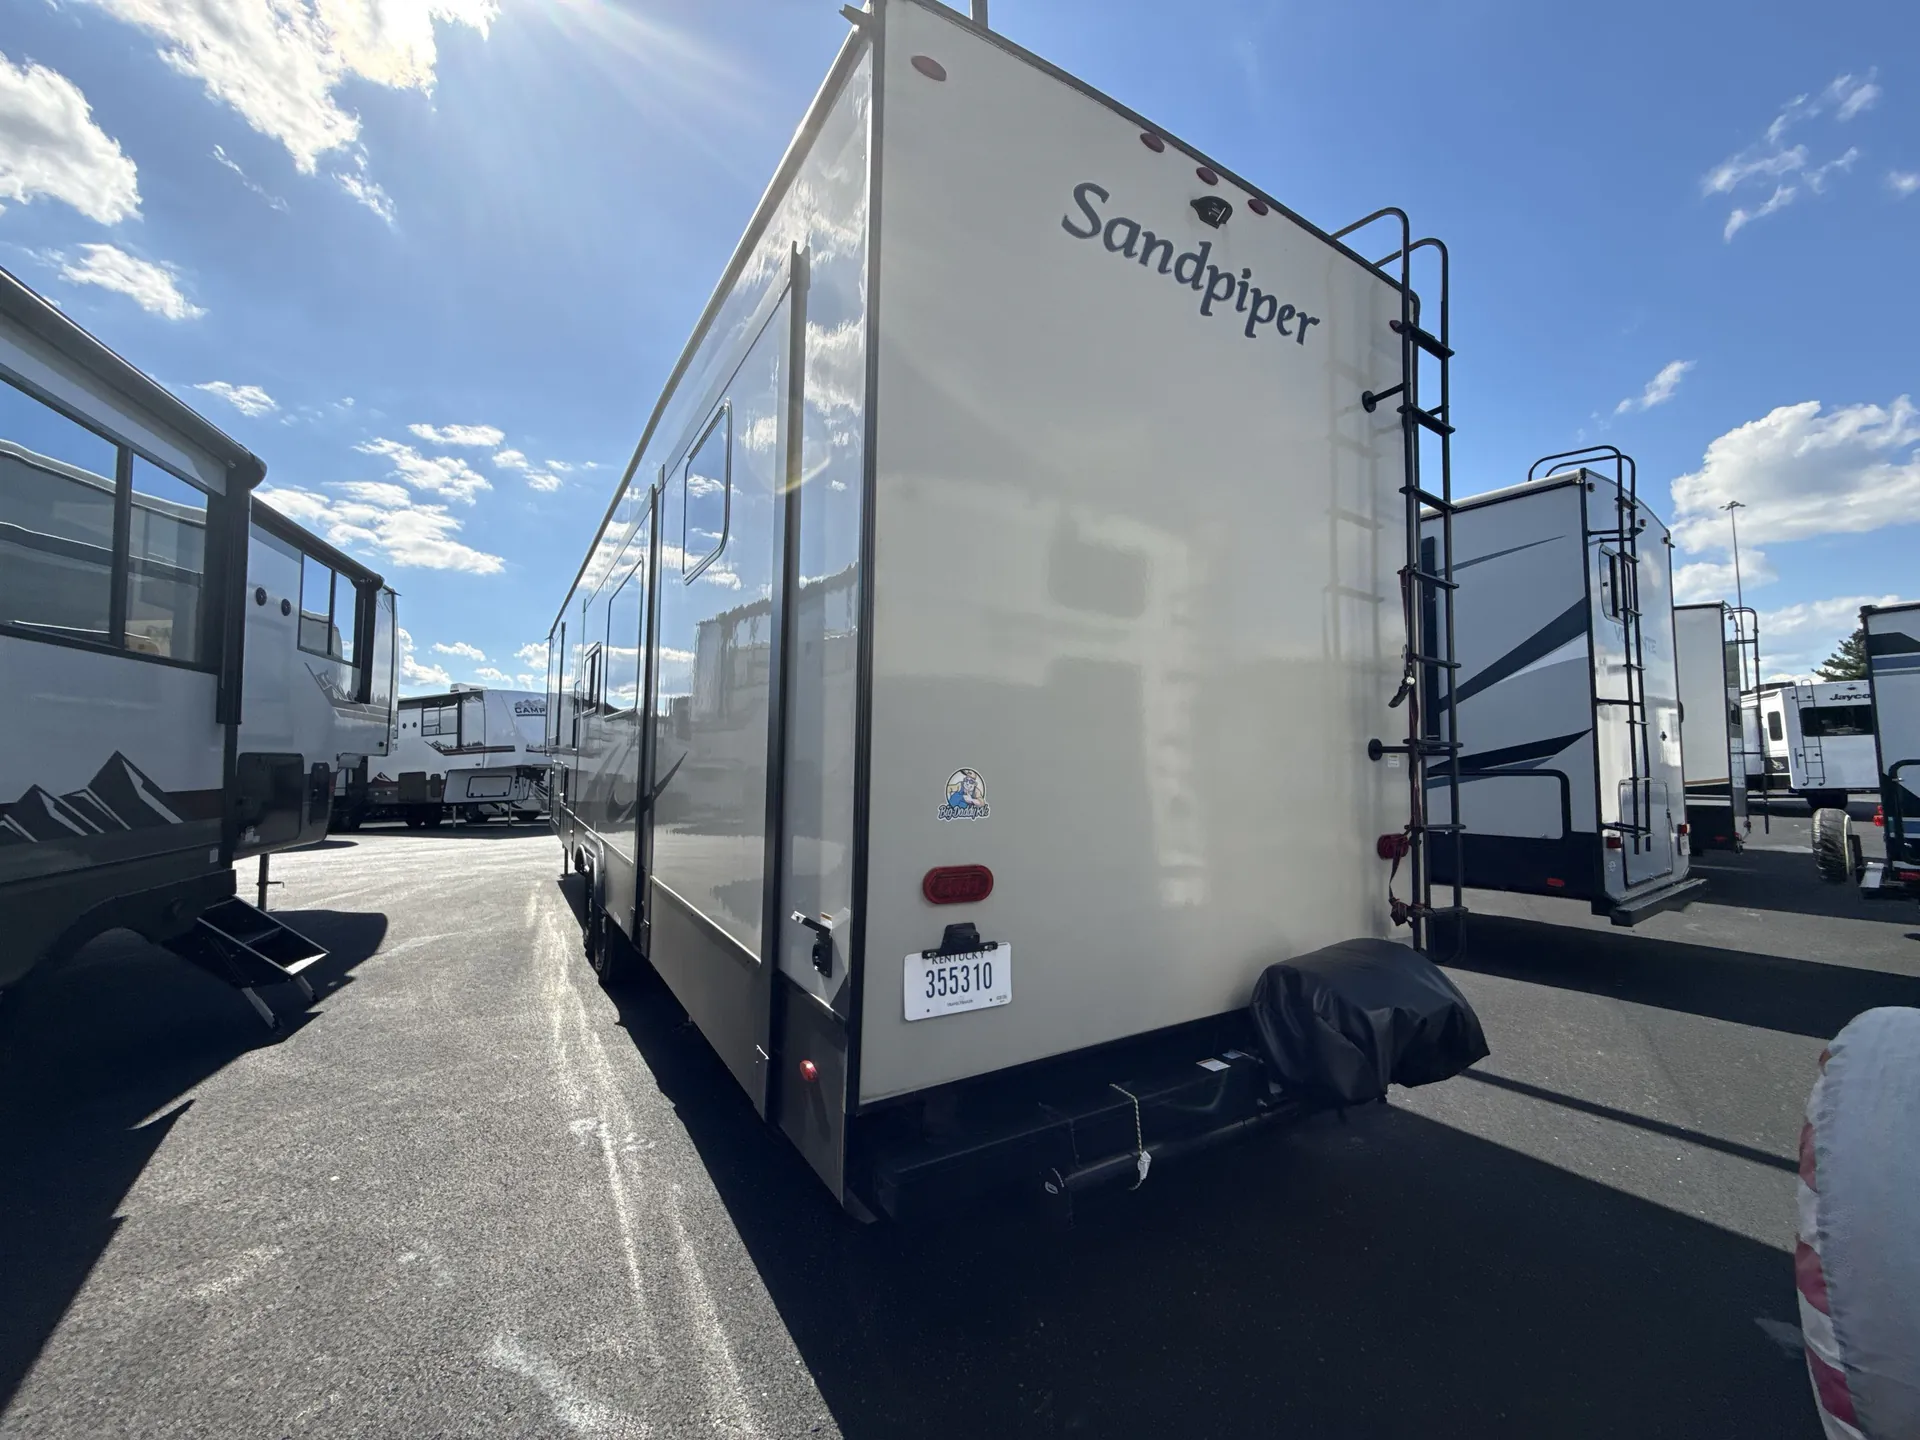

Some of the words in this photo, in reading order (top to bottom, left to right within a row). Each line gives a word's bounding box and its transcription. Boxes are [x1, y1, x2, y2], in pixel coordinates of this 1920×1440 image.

[1061, 182, 1320, 345] Sandpiper
[1829, 693, 1870, 701] Jayco
[938, 804, 953, 820] Big
[952, 804, 977, 820] Daddy
[931, 950, 985, 965] KENTUCKY
[925, 961, 992, 999] 355310
